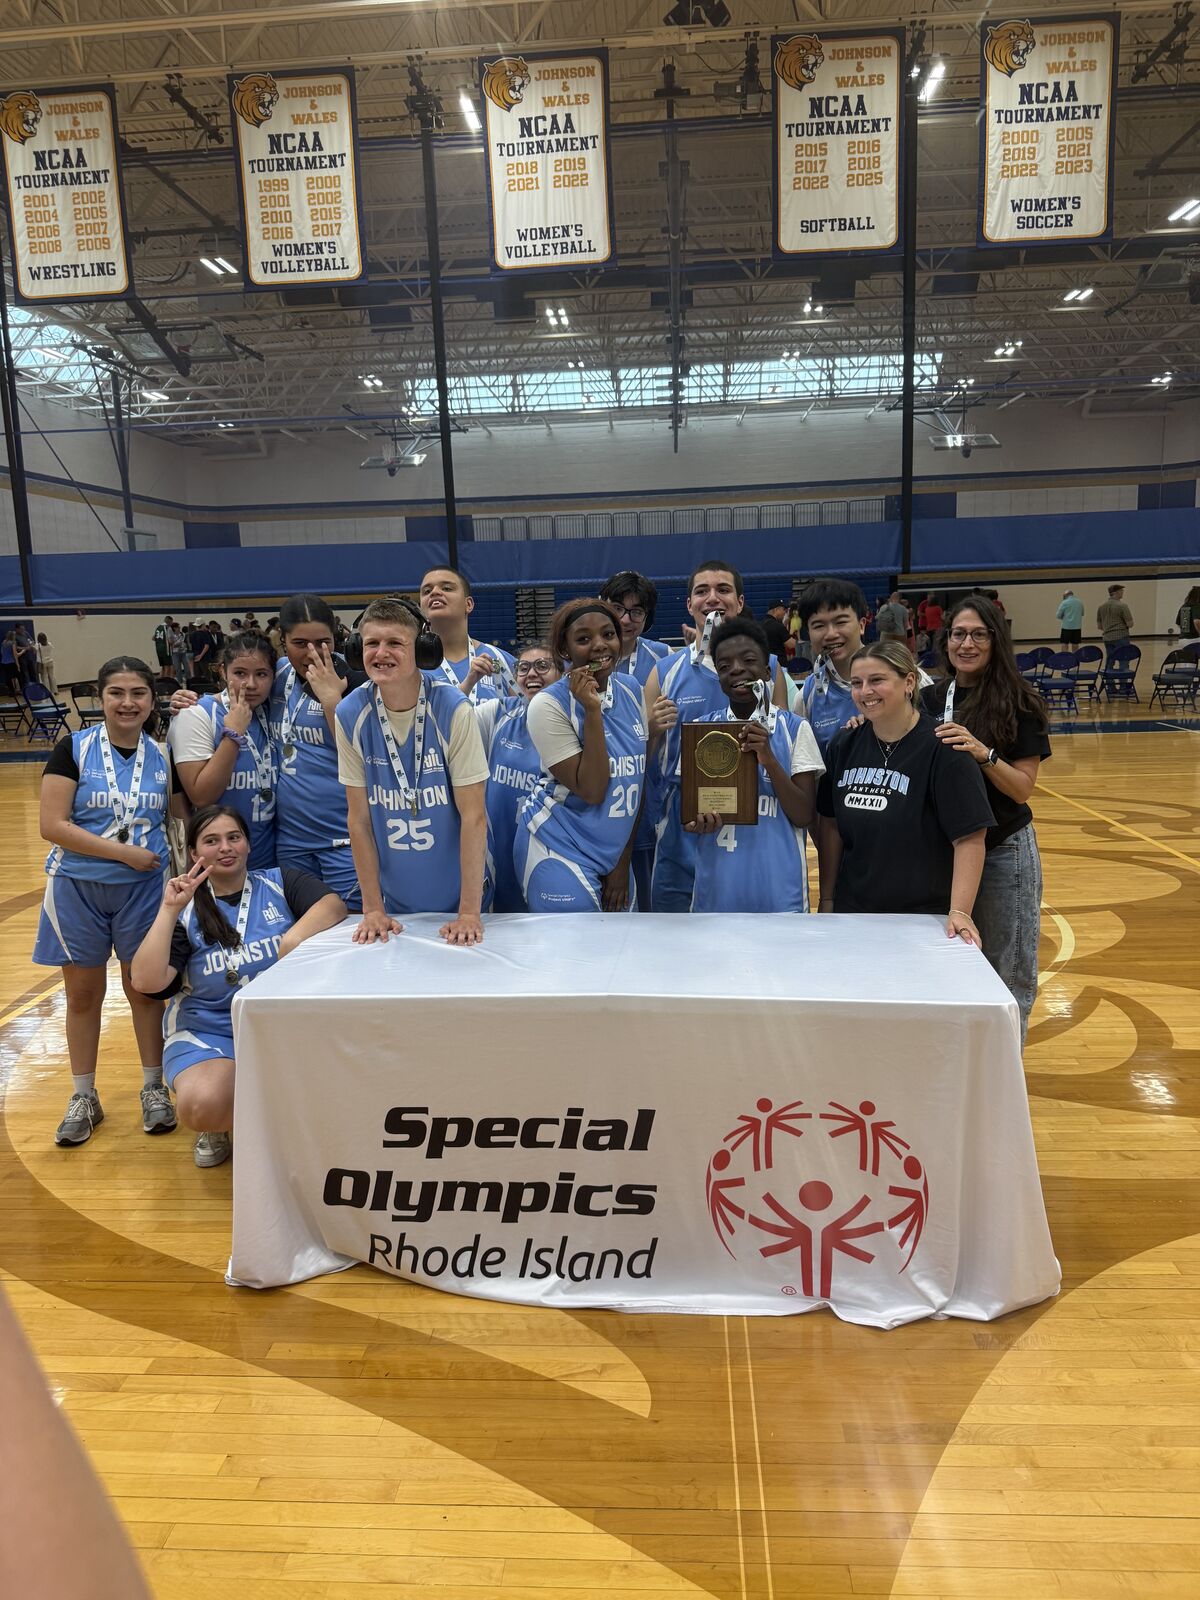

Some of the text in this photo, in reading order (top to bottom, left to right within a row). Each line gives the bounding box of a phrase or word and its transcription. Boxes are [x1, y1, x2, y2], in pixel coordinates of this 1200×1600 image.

[1040, 30, 1105, 47] JOHNSON
[829, 46, 892, 60] JOHNSON
[1068, 47, 1076, 57] &
[534, 66, 596, 81] JOHNSON
[856, 61, 864, 72] &
[1046, 60, 1097, 74] WALES
[561, 81, 570, 92] &
[835, 74, 885, 88] WALES
[283, 84, 343, 99] JOHNSON
[542, 93, 590, 108] WALES
[1019, 80, 1078, 105] NCAA
[46, 100, 104, 115] JOHNSON
[310, 99, 318, 110] &
[809, 95, 867, 118] NCAA
[72, 116, 80, 127] &
[291, 112, 338, 125] WALES
[995, 104, 1102, 124] TOURNAMENT
[518, 113, 576, 138] NCAA
[785, 118, 891, 138] TOURNAMENT
[55, 128, 100, 142] WALES
[268, 131, 324, 155] NCAA
[1002, 127, 1093, 144] 2000 2005
[496, 135, 599, 157] TOURNAMENT
[795, 139, 880, 157] 2015 2016
[1003, 143, 1091, 161] 2019 2021
[33, 148, 88, 171] NCAA
[249, 153, 346, 174] TOURNAMENT
[507, 157, 586, 176] 2018 2019
[795, 156, 881, 174] 2017 2018
[1001, 159, 1093, 178] 2022 2023
[15, 170, 110, 189] TOURNAMENT
[258, 175, 341, 193] 1999 2000
[508, 173, 589, 192] 2021 2022
[793, 171, 883, 190] 2022 2025
[23, 191, 106, 208] 2001 2002
[259, 192, 342, 208] 2001 2002
[1011, 196, 1081, 213] WOMEN'S
[25, 206, 108, 224] 2004 2005
[261, 207, 342, 224] 2010 2015
[1016, 214, 1074, 229] SOCCER
[27, 222, 108, 239] 2006 2007
[262, 223, 342, 241] 2016 2017
[516, 224, 583, 242] WOMEN'S
[800, 216, 875, 233] SOFTBALL
[29, 238, 110, 255] 2008 2009
[272, 241, 337, 257] WOMEN'S
[505, 240, 596, 259] VOLLEYBALL
[28, 262, 116, 281] WRESTLING
[261, 257, 349, 274] VOLLEYBALL
[837, 767, 911, 796] JOHNSTON
[847, 785, 893, 795] PANTHERS
[608, 783, 640, 817] 20
[847, 795, 883, 808] MMXXII
[386, 818, 435, 851] 25
[716, 825, 738, 852] 4
[383, 1107, 657, 1159] Special
[323, 1168, 658, 1223] Olympics
[369, 1232, 659, 1283] Rhode Island
